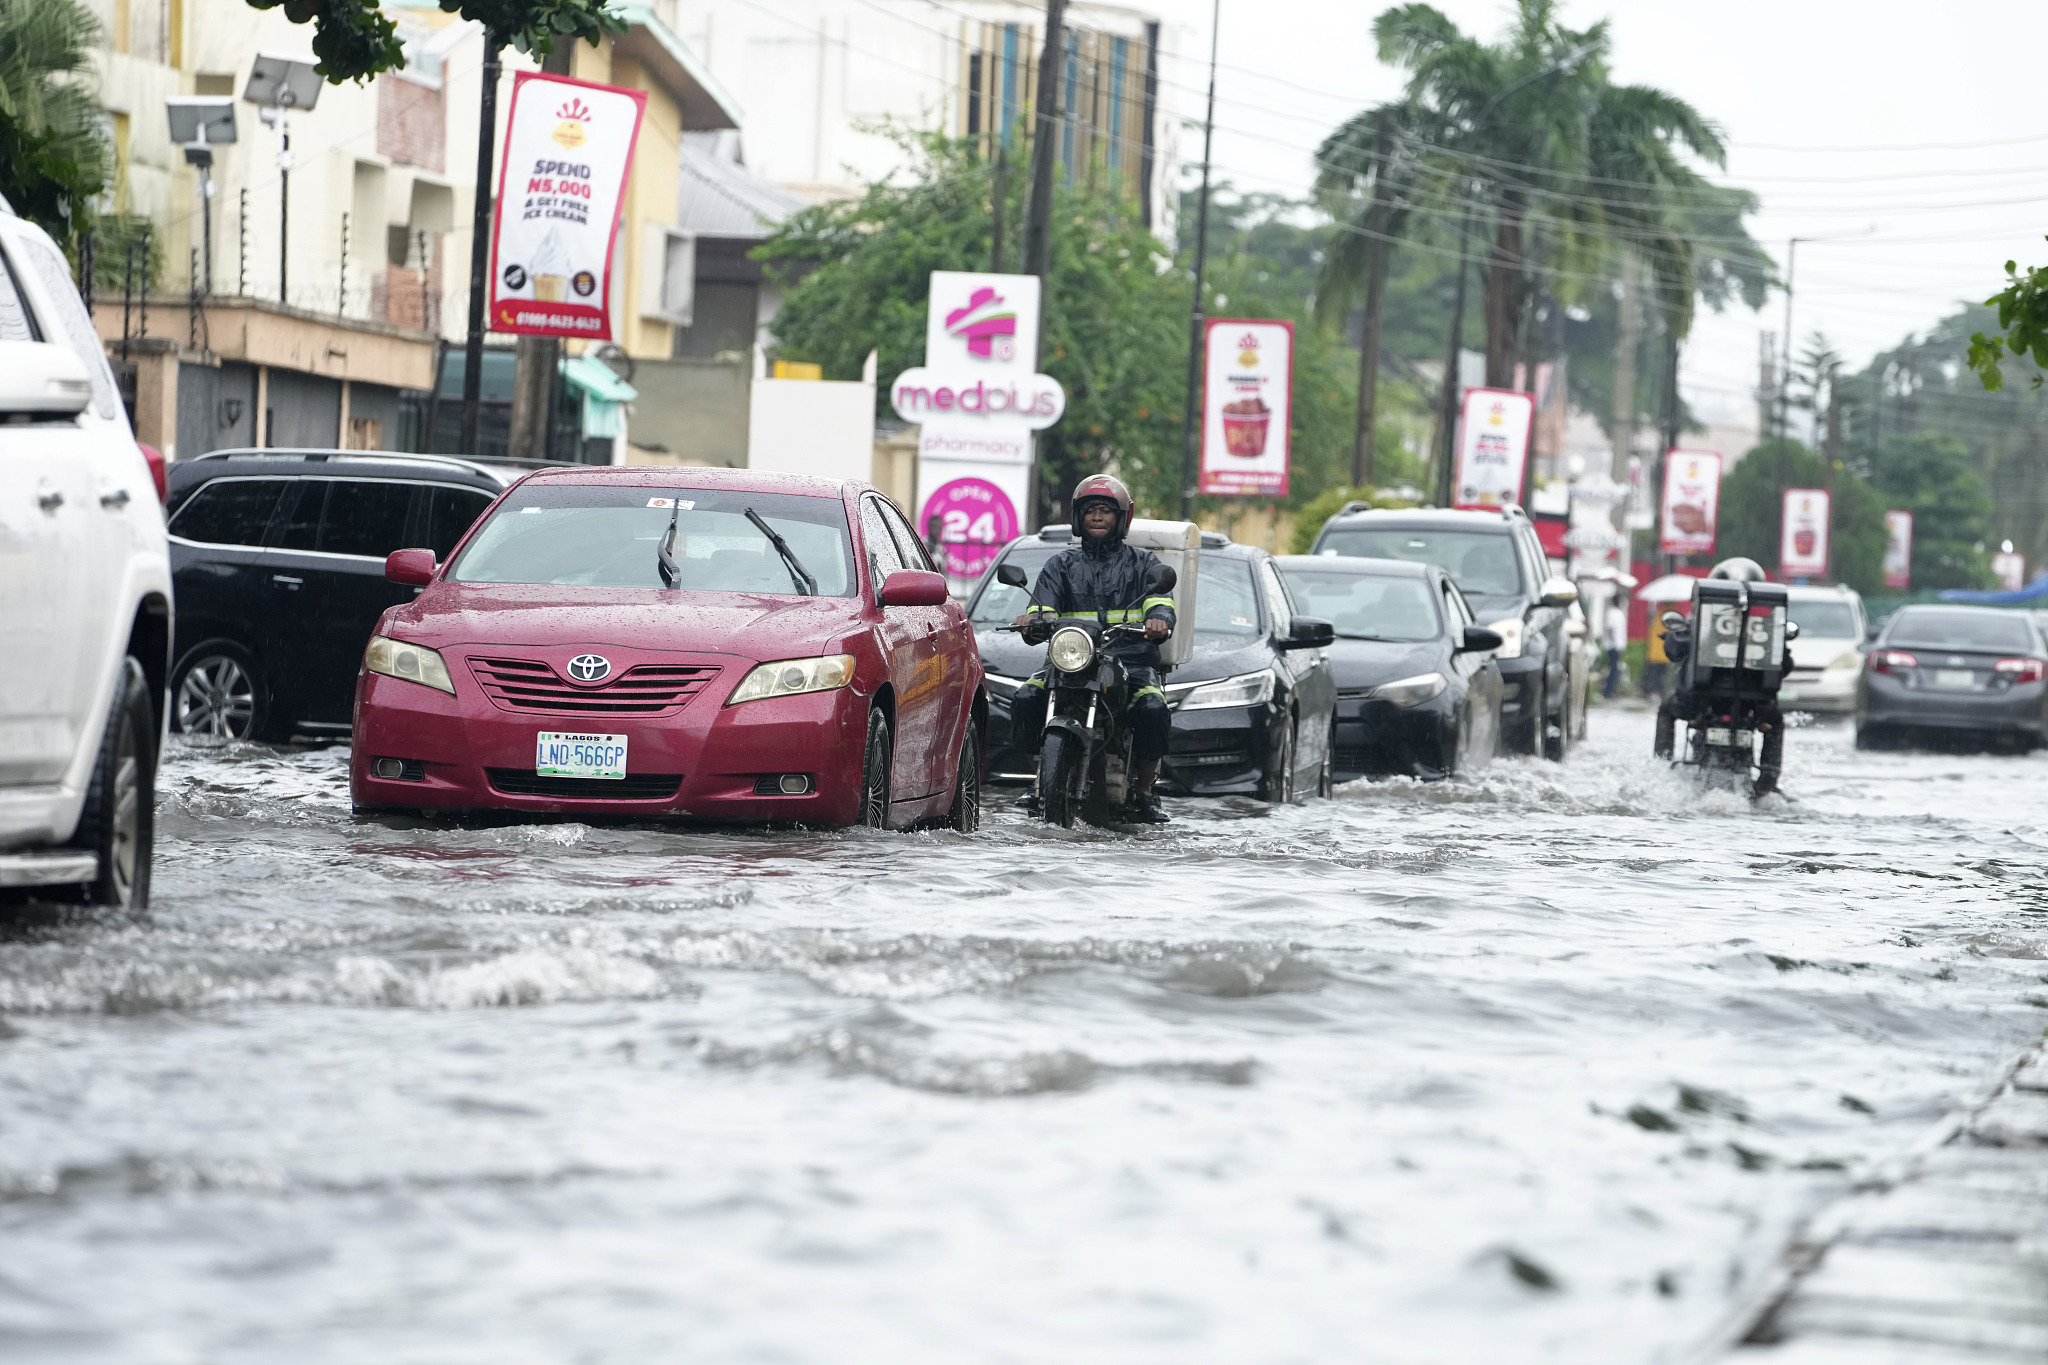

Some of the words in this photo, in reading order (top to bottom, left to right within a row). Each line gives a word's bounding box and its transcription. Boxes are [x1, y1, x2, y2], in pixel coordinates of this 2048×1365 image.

[533, 160, 590, 179] SPEND
[537, 197, 557, 206] GET
[562, 200, 588, 213] FREE
[523, 209, 541, 220] ICE
[546, 209, 587, 225] CREAM
[898, 379, 1057, 420] medplus
[924, 436, 1024, 457] pharmacy
[949, 485, 993, 503] OPEN
[943, 510, 996, 544] 24
